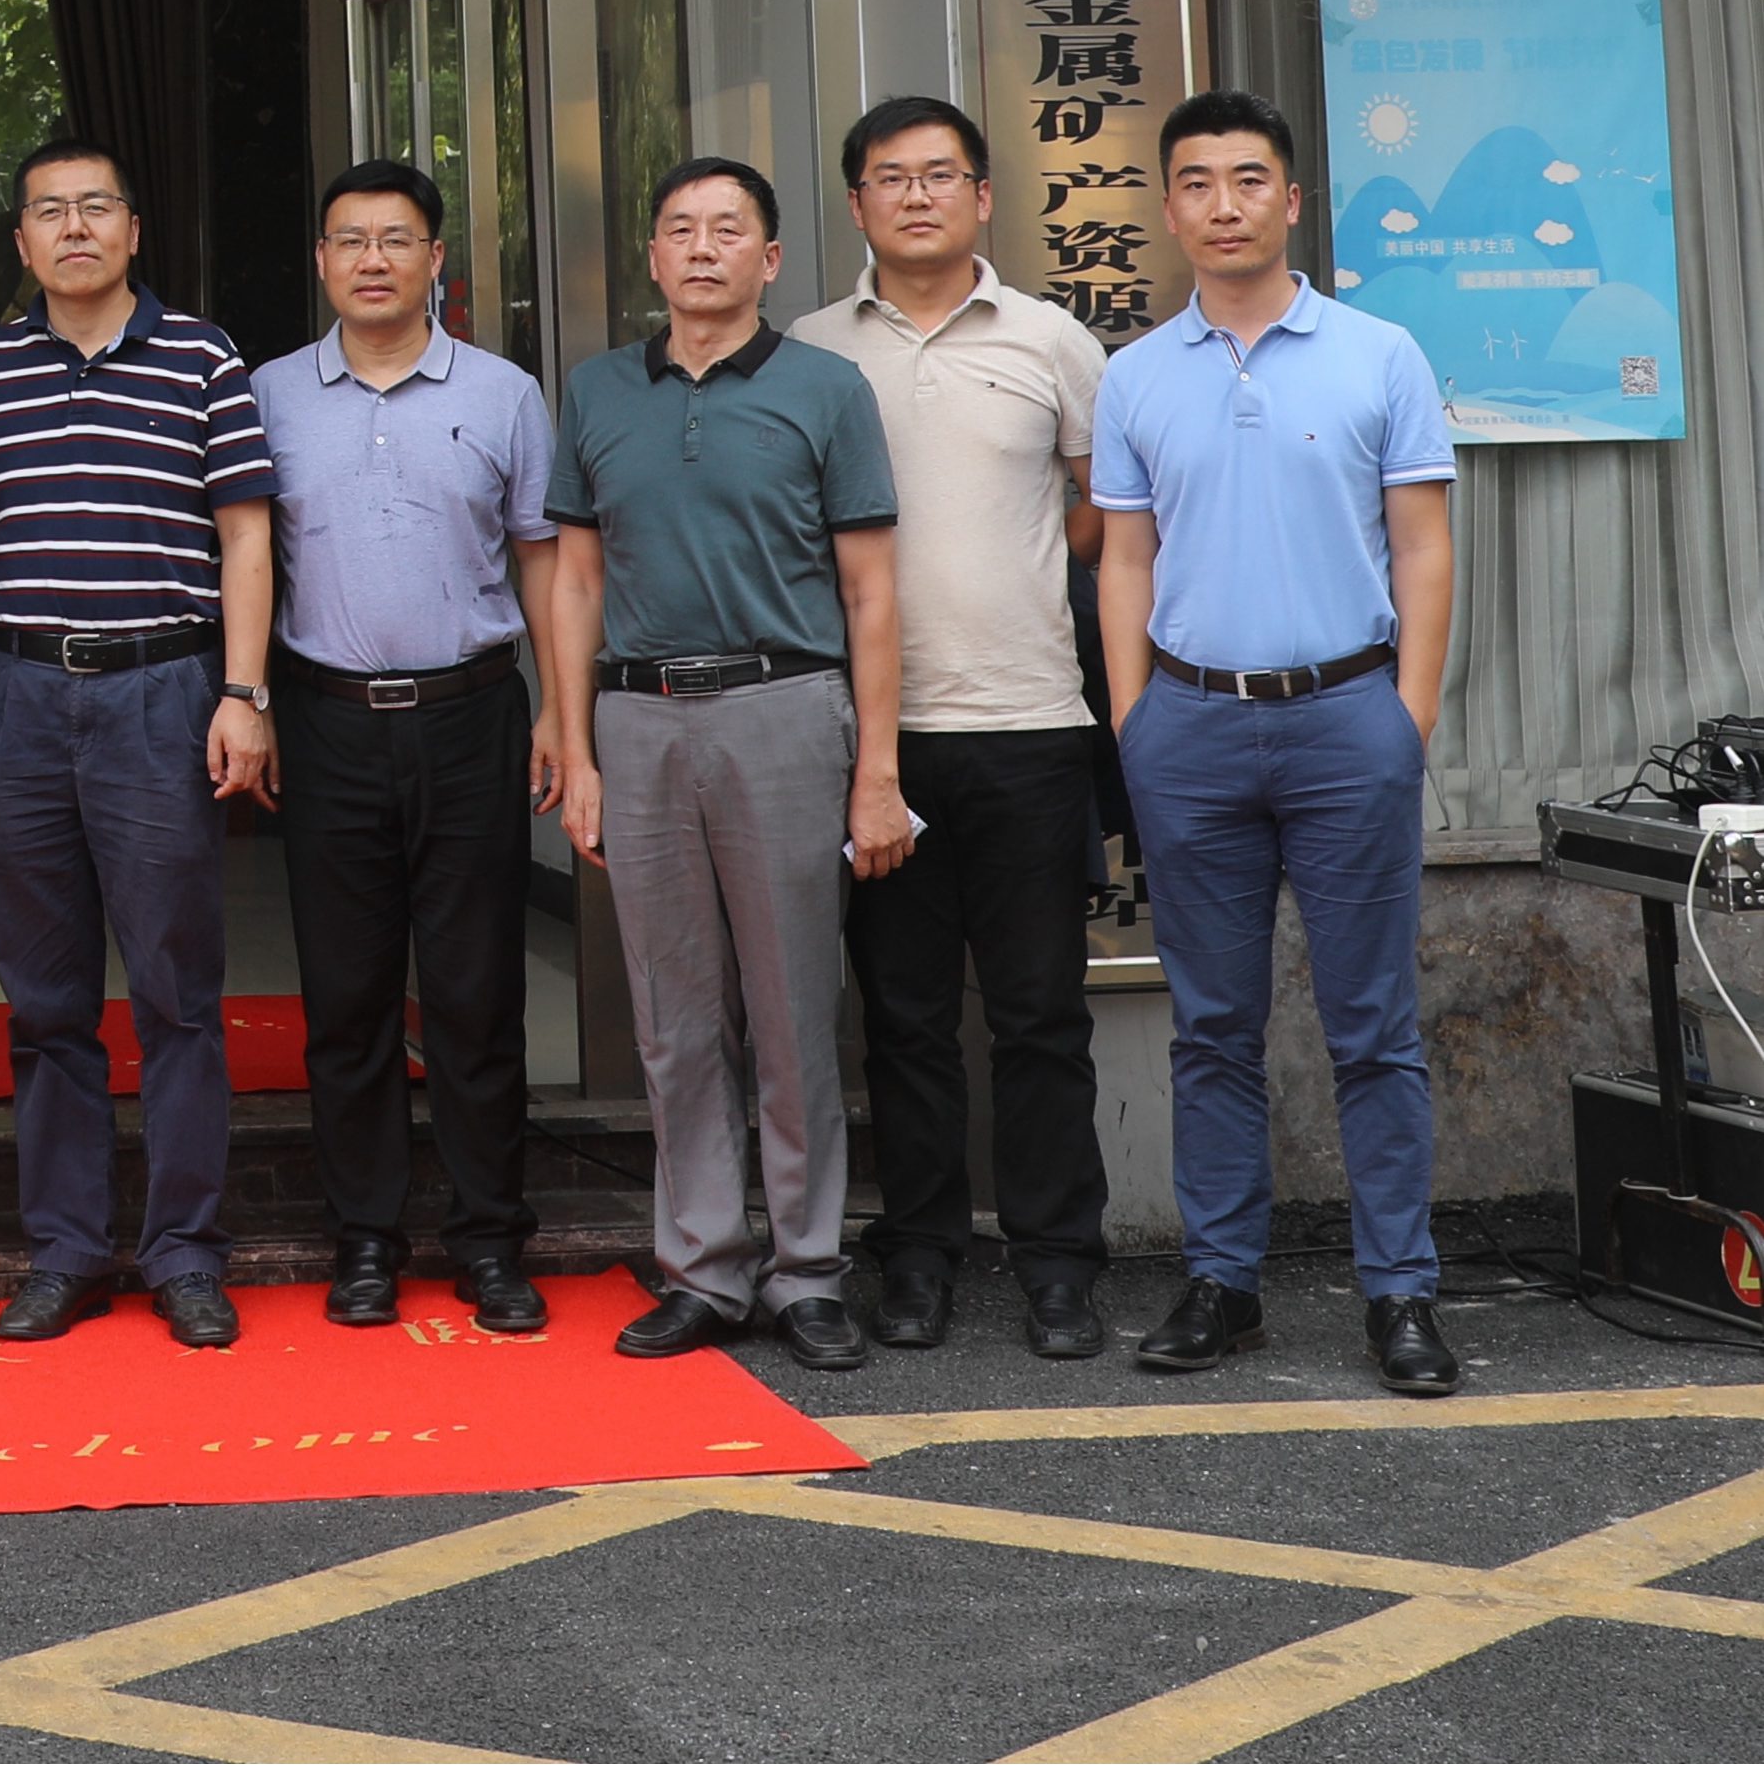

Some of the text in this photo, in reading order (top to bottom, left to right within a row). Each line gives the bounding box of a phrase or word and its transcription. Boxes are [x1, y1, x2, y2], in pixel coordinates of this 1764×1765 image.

[1385, 238, 1516, 256] 美丽中国 共享生活
